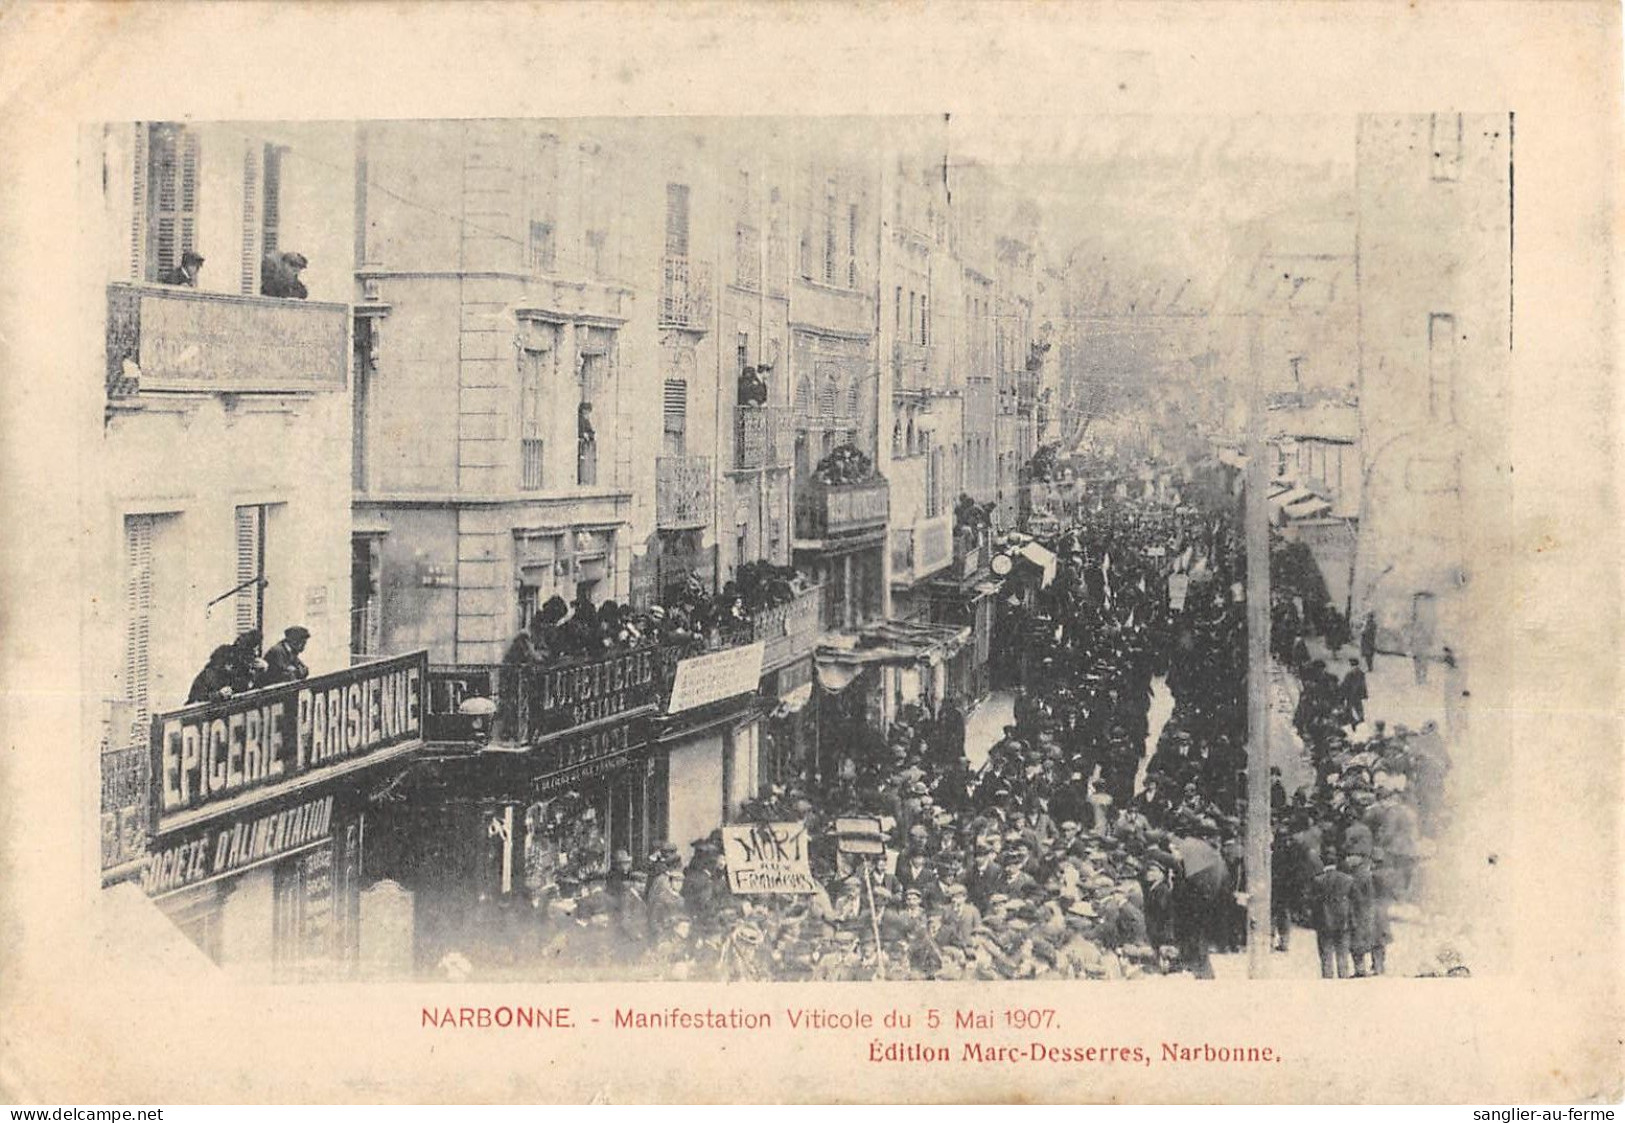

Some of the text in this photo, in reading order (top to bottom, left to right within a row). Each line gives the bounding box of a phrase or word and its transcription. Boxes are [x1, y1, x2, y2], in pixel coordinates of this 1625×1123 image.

[162, 702, 285, 811] EPICERIE
[297, 667, 420, 769] PARISIENNE
[213, 795, 333, 873] D'ALIMENTATION
[733, 823, 806, 862] MORT
